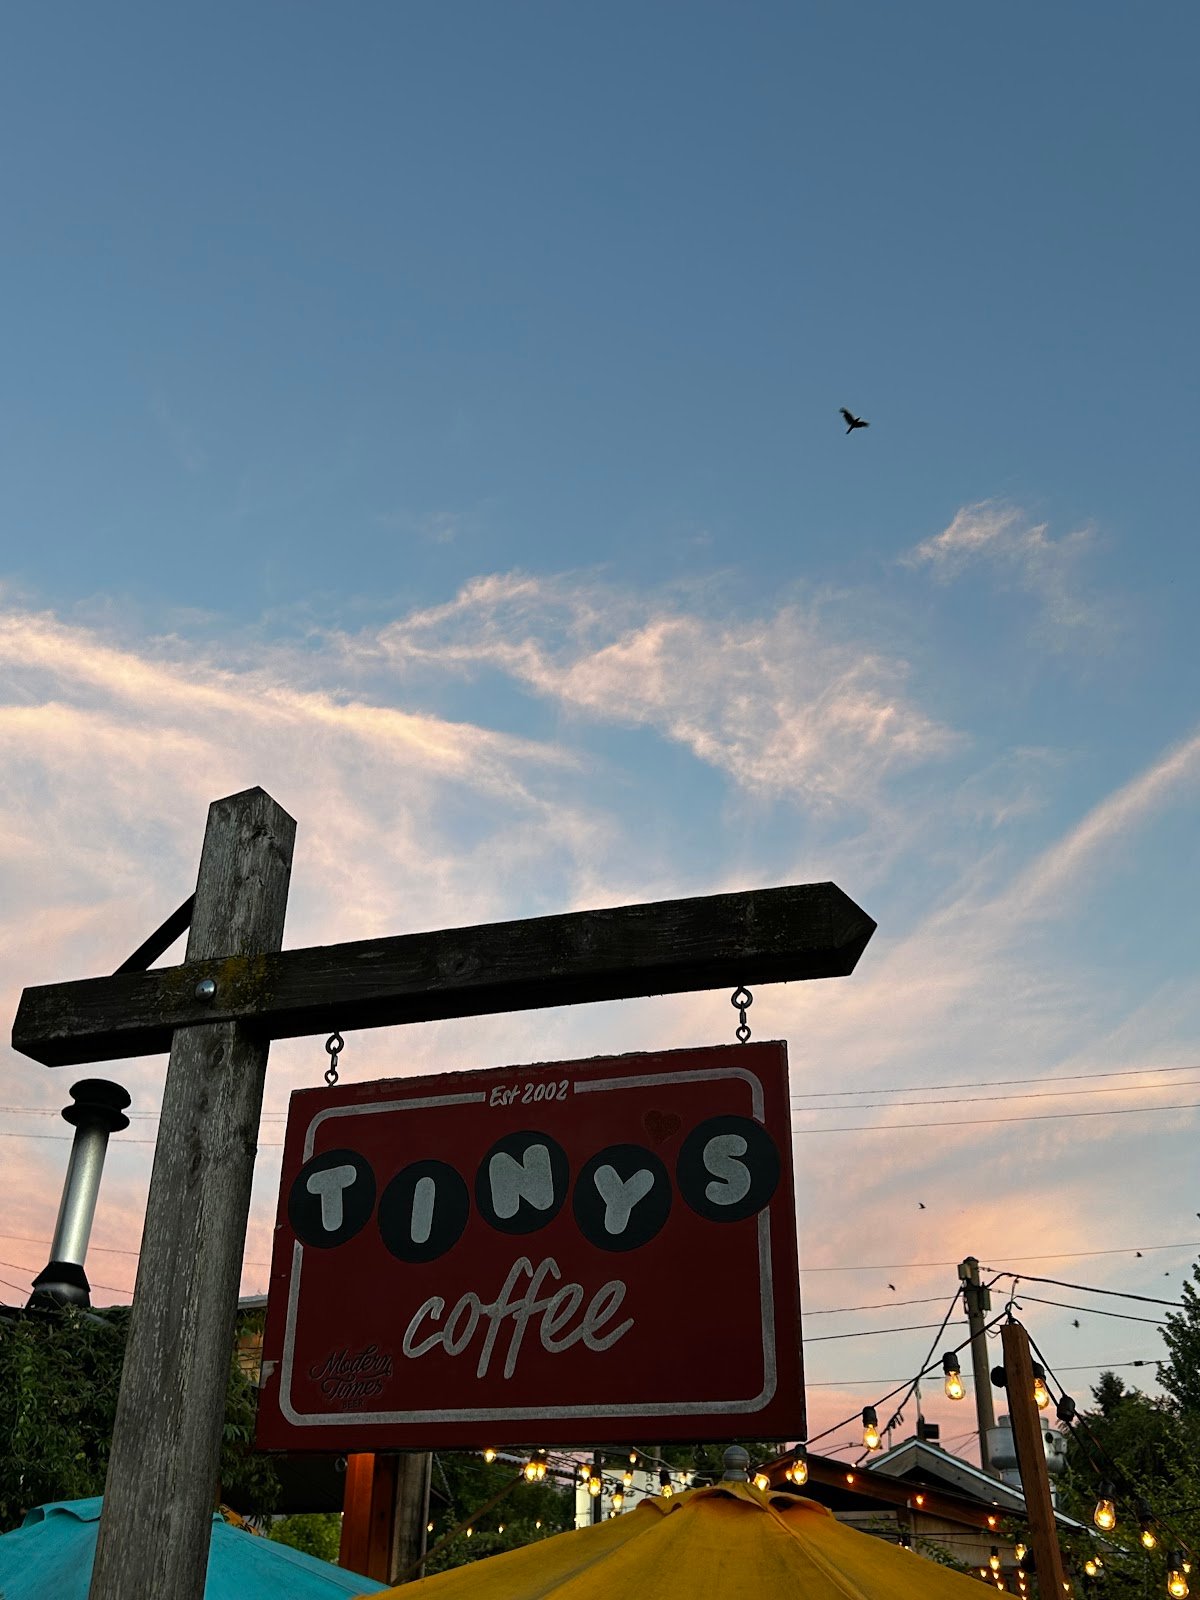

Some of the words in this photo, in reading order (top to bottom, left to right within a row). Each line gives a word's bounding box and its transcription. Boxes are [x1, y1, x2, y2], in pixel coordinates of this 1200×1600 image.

[489, 1084, 520, 1107] Est
[521, 1079, 570, 1104] 2002
[306, 1133, 752, 1244] TINYS
[402, 1255, 635, 1379] coffee
[309, 1343, 394, 1381] Modern
[320, 1374, 384, 1401] Times
[342, 1399, 364, 1409] BEER
